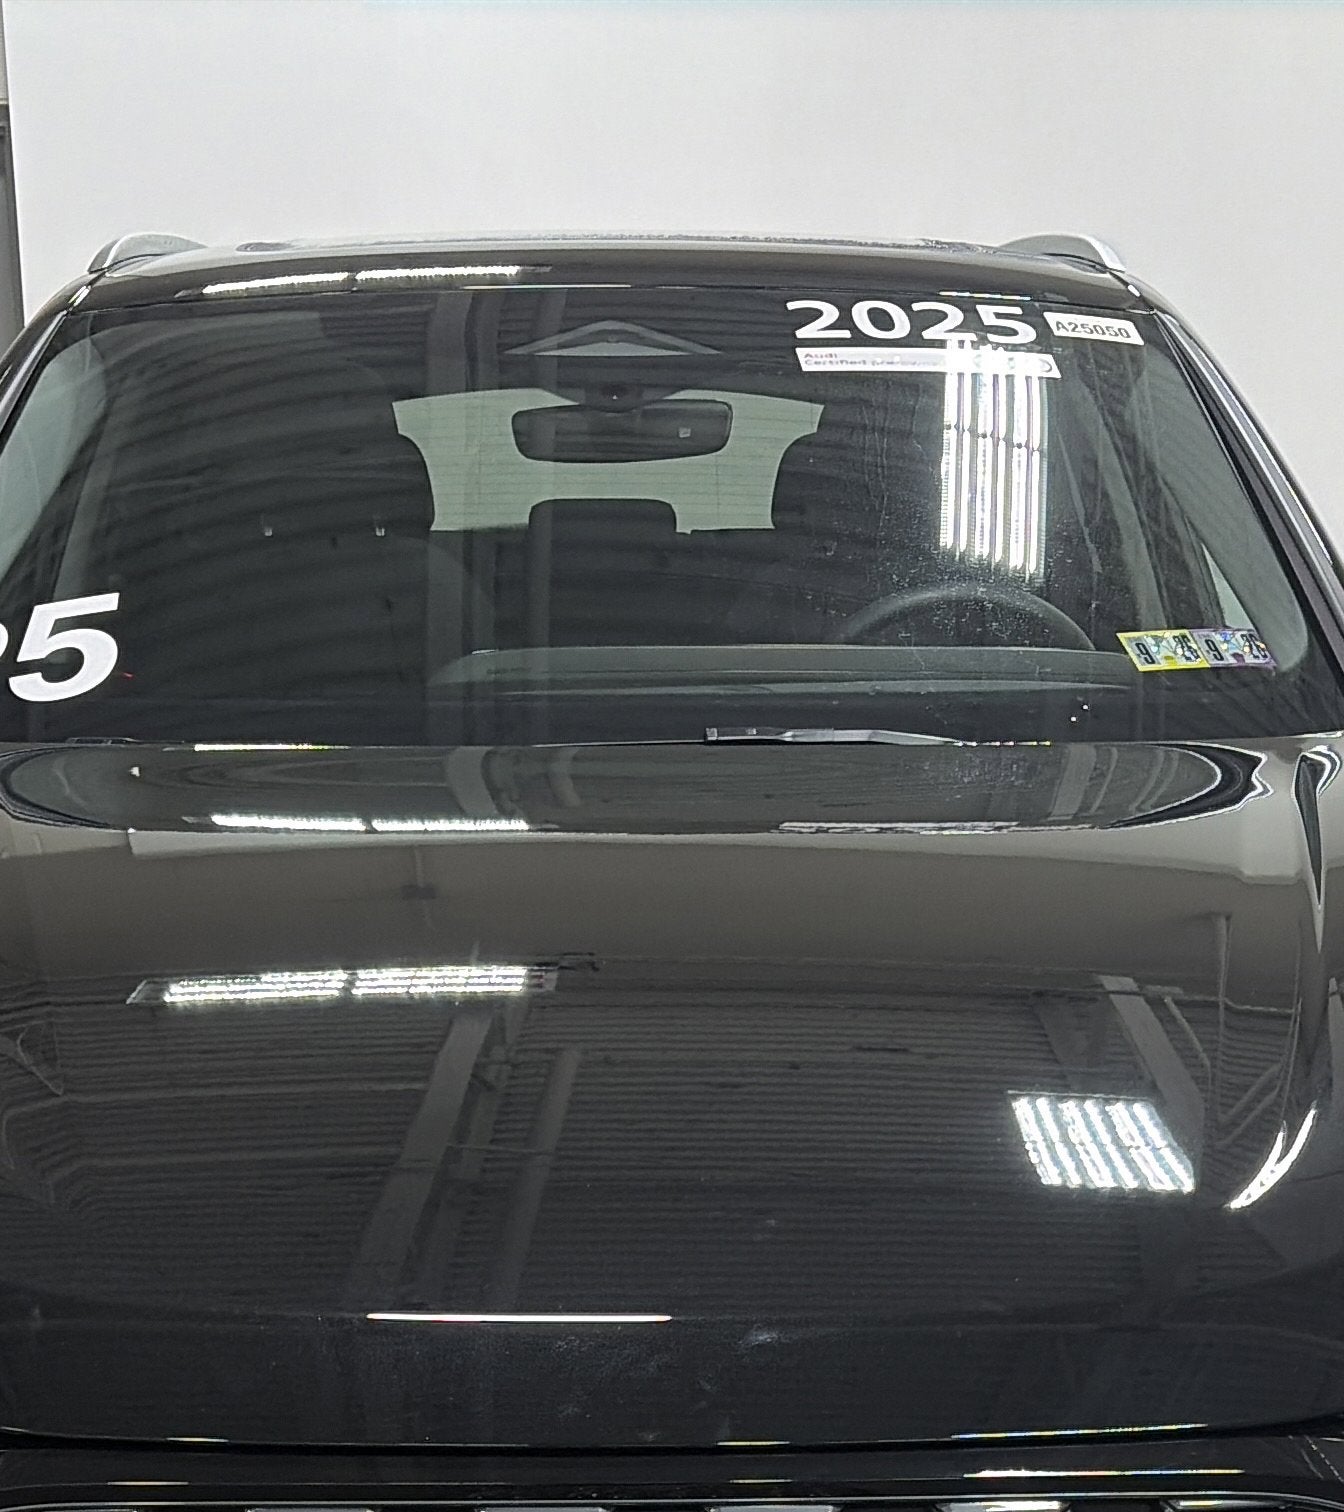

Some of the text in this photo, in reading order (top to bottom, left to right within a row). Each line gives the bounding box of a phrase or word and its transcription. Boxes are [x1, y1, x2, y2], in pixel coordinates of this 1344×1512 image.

[786, 300, 1037, 345] 2025
[1055, 320, 1131, 339] A25050
[1135, 642, 1155, 665] 9
[1204, 639, 1224, 662] 9
